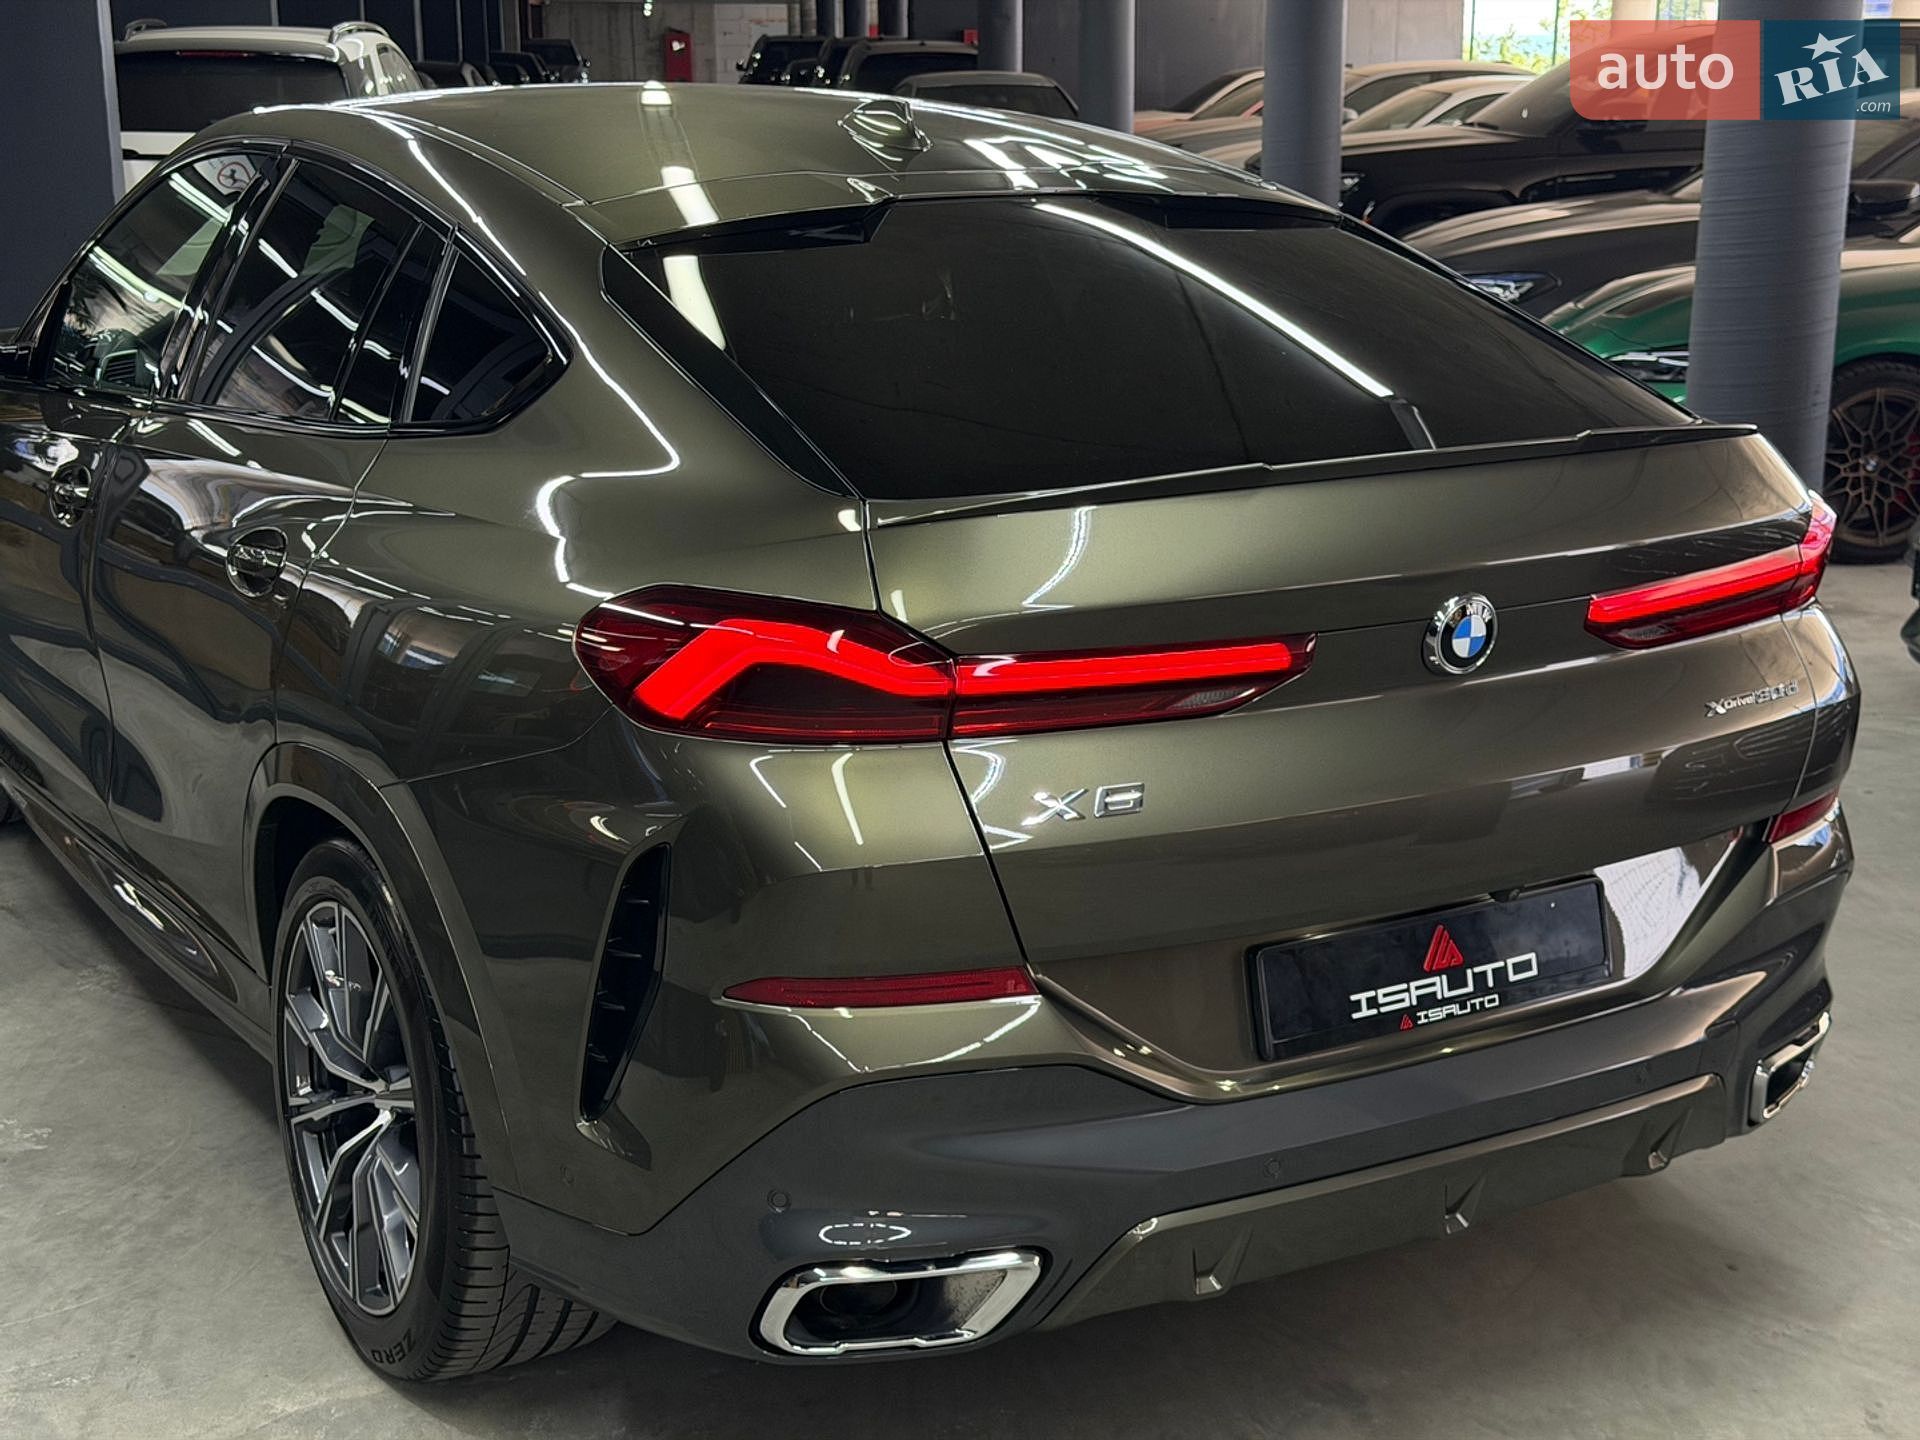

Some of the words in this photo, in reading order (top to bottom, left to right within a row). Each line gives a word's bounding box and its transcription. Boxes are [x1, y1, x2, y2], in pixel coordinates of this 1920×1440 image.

[1021, 782, 1145, 827] X6
[1349, 951, 1539, 1020] ISAUTO
[1415, 993, 1500, 1025] ISAUTO
[370, 1327, 416, 1364] ZERO
